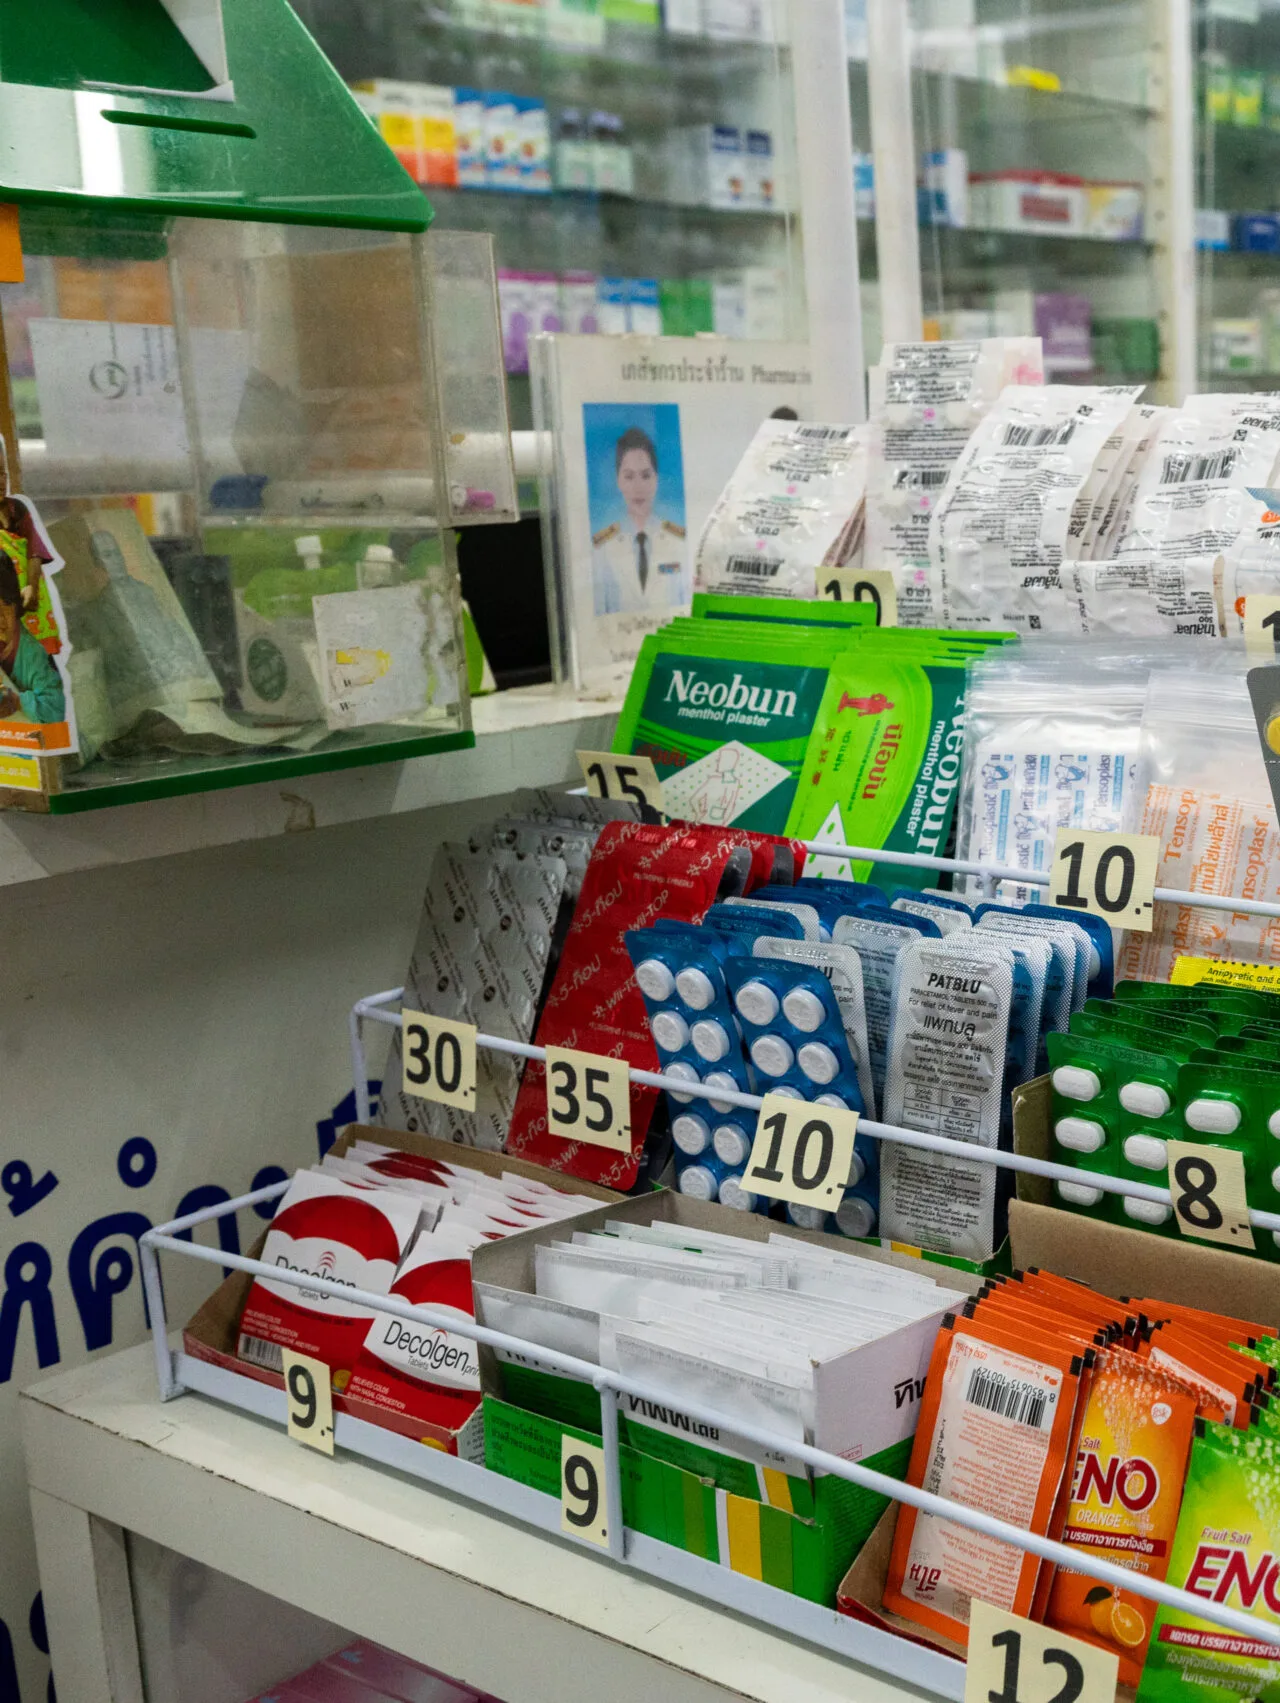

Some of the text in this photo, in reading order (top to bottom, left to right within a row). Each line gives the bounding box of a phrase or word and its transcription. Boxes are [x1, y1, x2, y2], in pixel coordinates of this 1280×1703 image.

[664, 669, 798, 717] Neobun
[677, 706, 772, 727] menthol plaster
[905, 719, 946, 837] menthol plaster
[1231, 815, 1270, 926] Tnsoplast
[927, 972, 982, 994] PATBLU
[1206, 966, 1255, 982] Antipyretic
[1256, 975, 1275, 985] and
[910, 987, 949, 1001] PARACETAMOL
[382, 1320, 470, 1372] Decolgen
[976, 1366, 1007, 1386] 100129
[1010, 1379, 1045, 1399] 850615
[1082, 1436, 1101, 1450] Salt
[1076, 1508, 1122, 1529] ORANGE
[1201, 1526, 1253, 1545] Fruit Salt
